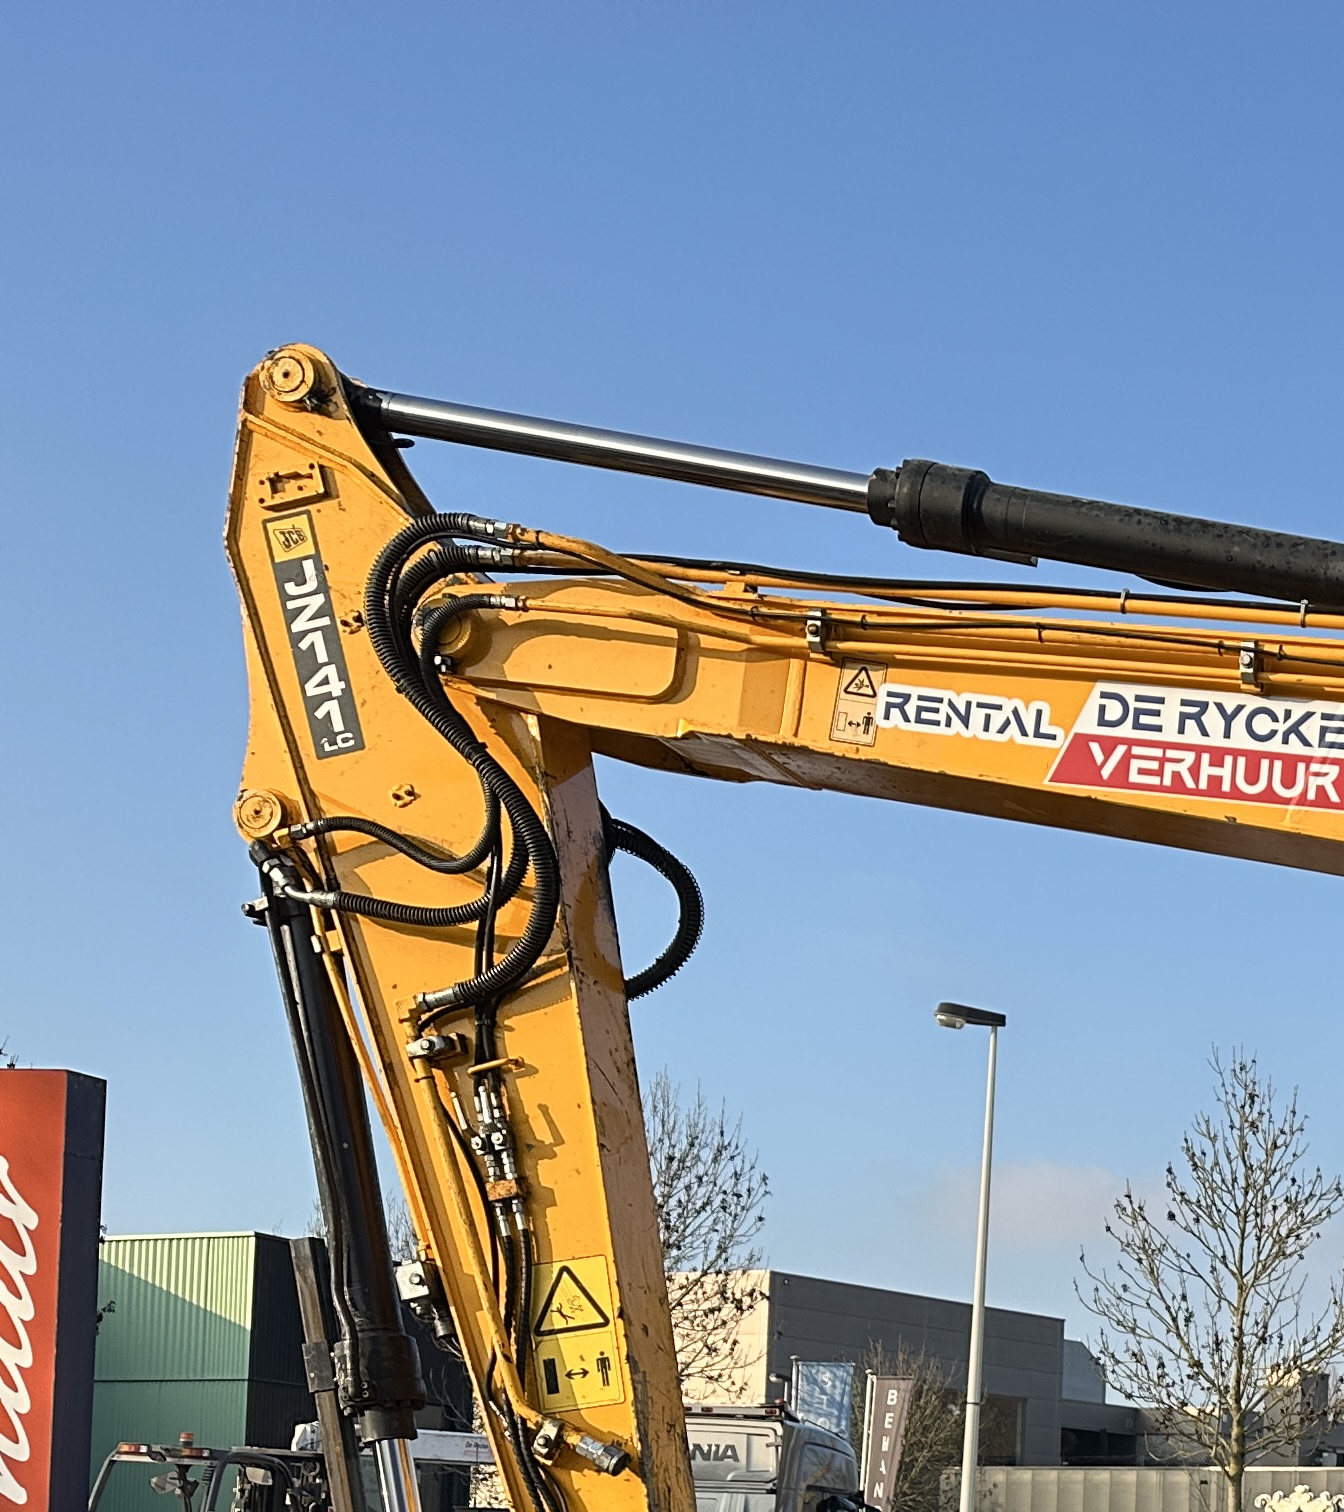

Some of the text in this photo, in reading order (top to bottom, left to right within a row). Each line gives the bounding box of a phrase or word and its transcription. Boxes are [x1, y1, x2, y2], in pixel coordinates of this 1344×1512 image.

[281, 527, 307, 550] JCB
[883, 690, 1057, 741] RENTAL
[1097, 691, 1165, 733] DE
[1088, 741, 1341, 803] VERHUUR
[691, 1443, 740, 1462] NIA
[873, 1389, 898, 1511] BEHAN
